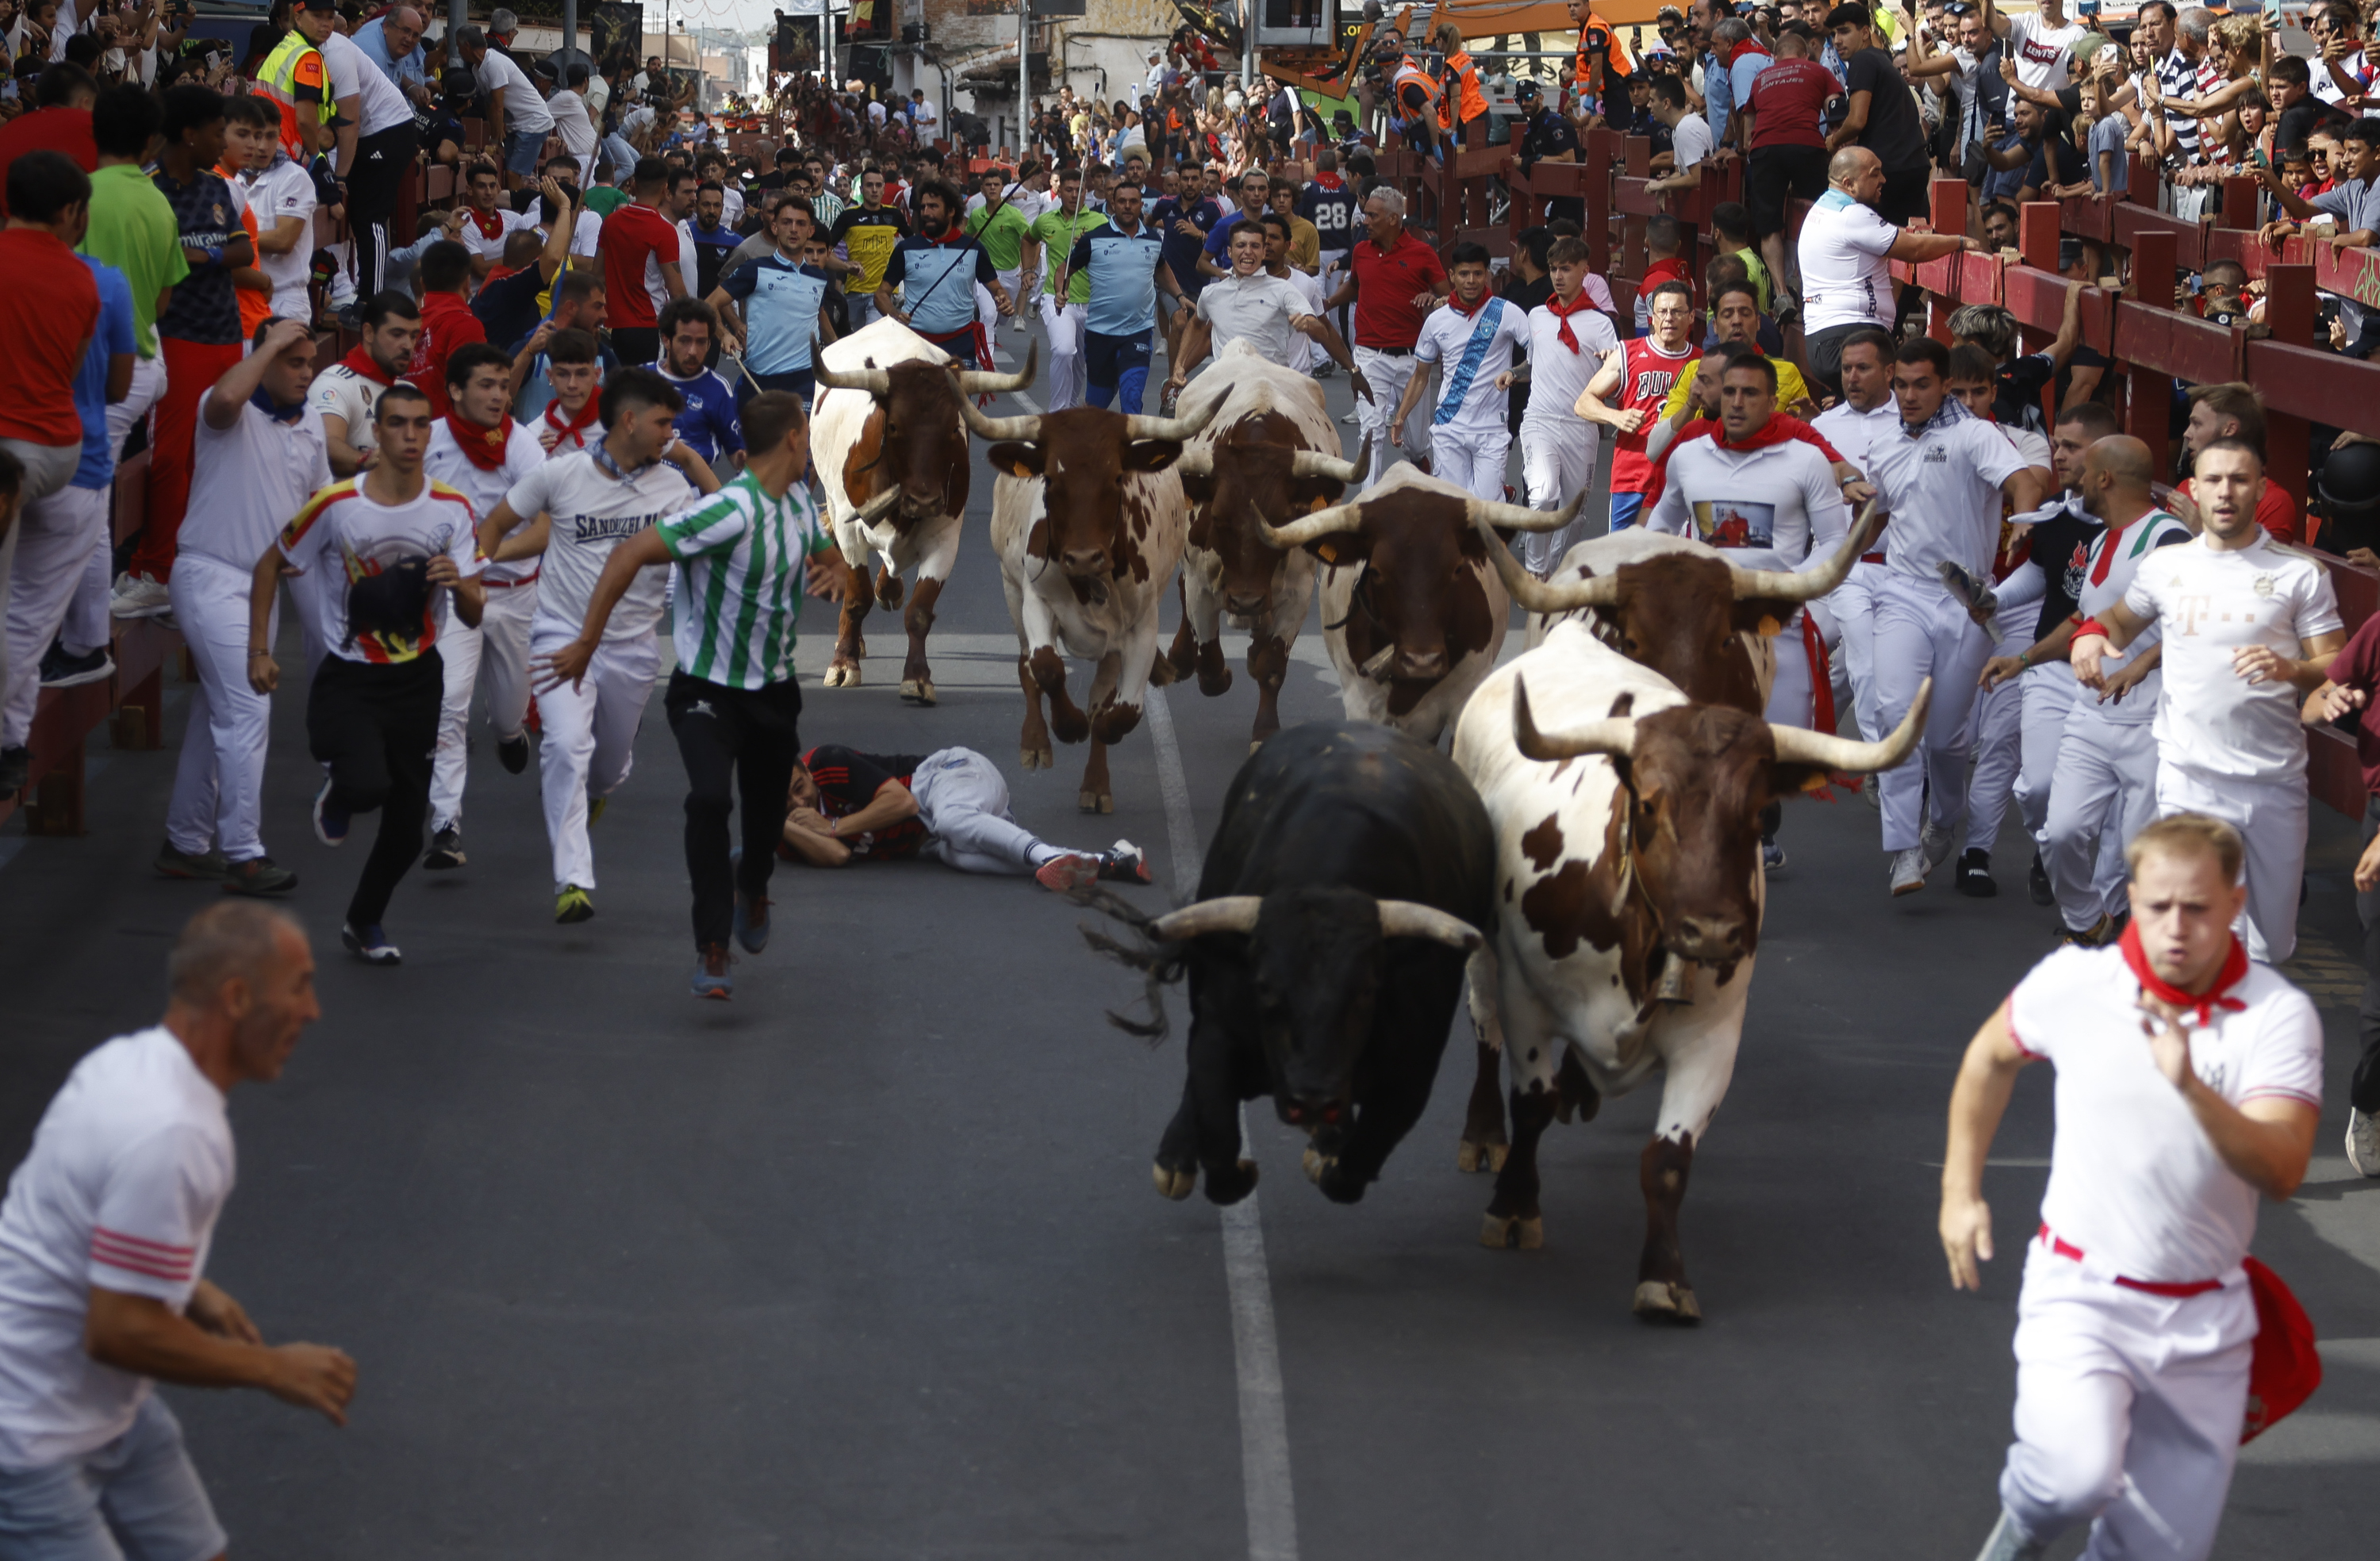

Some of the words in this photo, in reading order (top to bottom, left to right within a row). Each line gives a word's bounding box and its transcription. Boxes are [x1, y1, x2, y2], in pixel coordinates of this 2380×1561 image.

[1758, 77, 1805, 94] MONTAJES
[1315, 202, 1346, 229] 28
[178, 232, 228, 249] mirates
